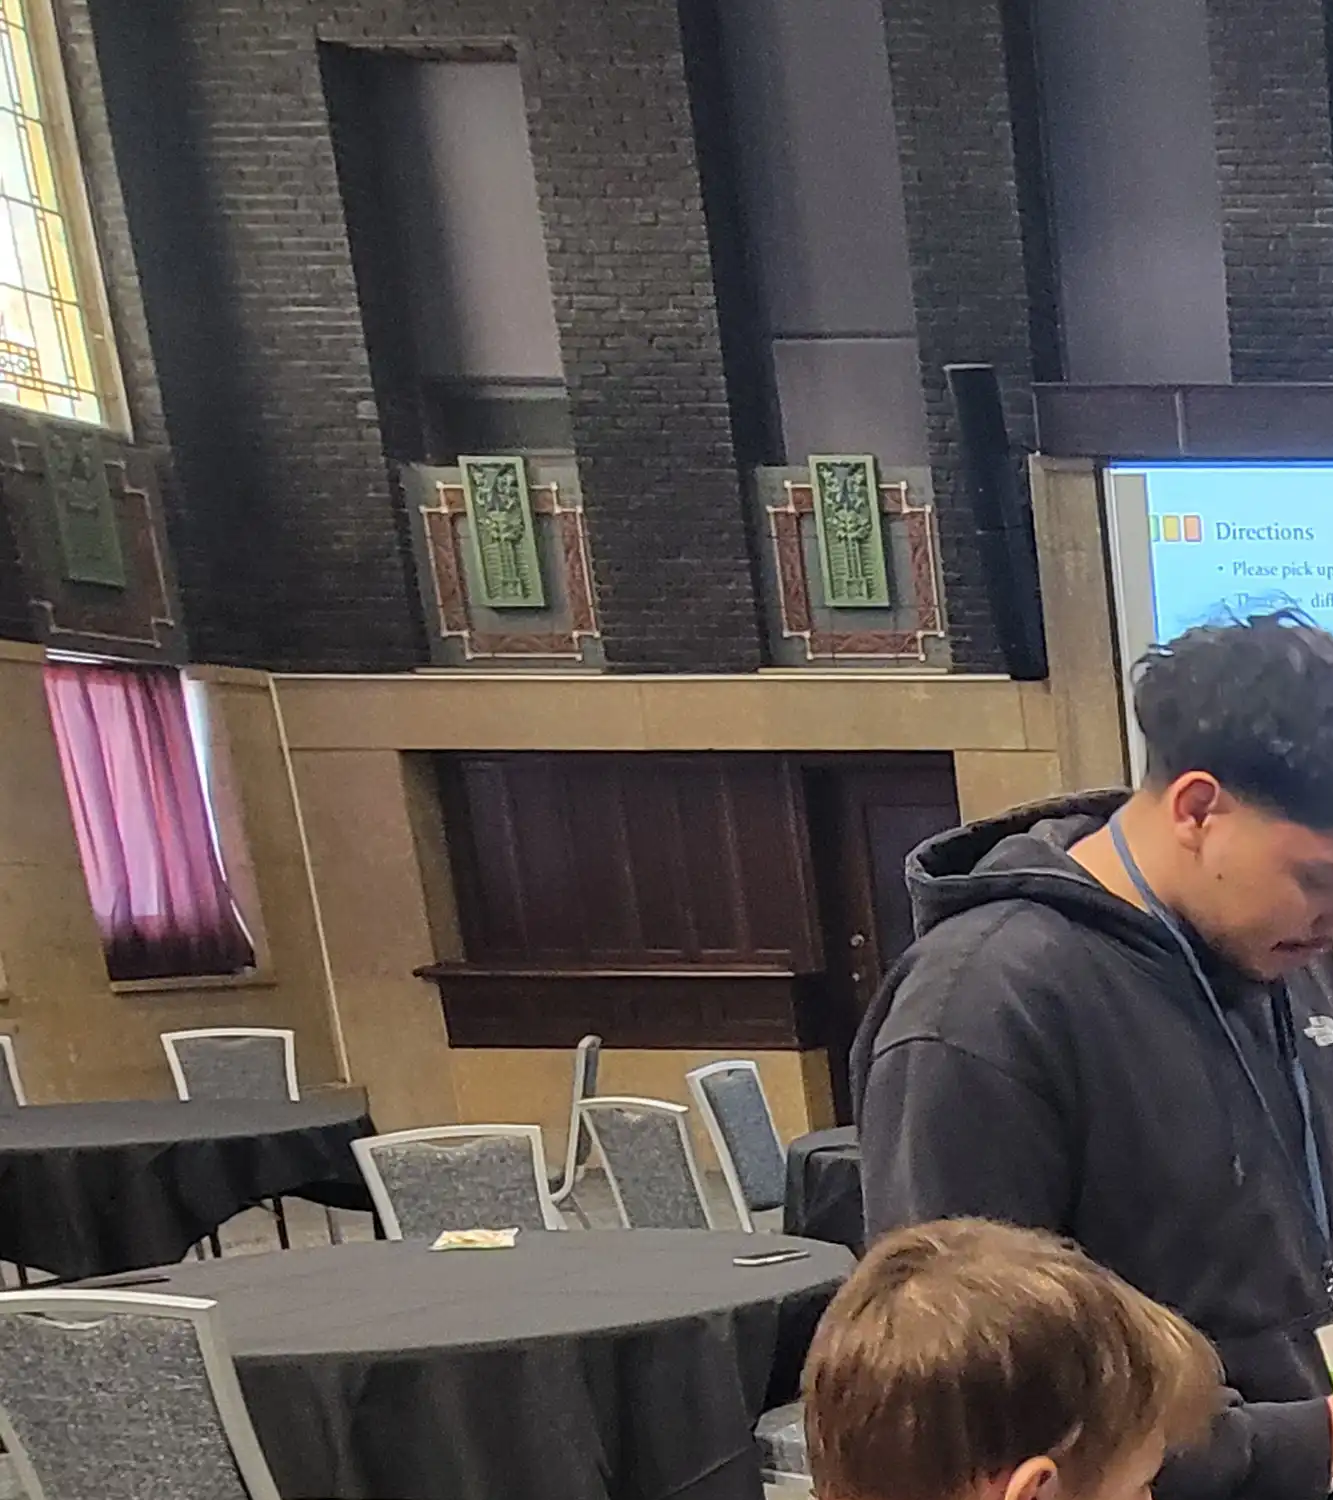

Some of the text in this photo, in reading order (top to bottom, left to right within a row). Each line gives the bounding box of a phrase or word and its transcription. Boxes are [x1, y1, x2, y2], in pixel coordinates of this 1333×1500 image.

[1215, 521, 1315, 541] Directions
[1232, 561, 1277, 577] Please
[1281, 561, 1313, 580] pick
